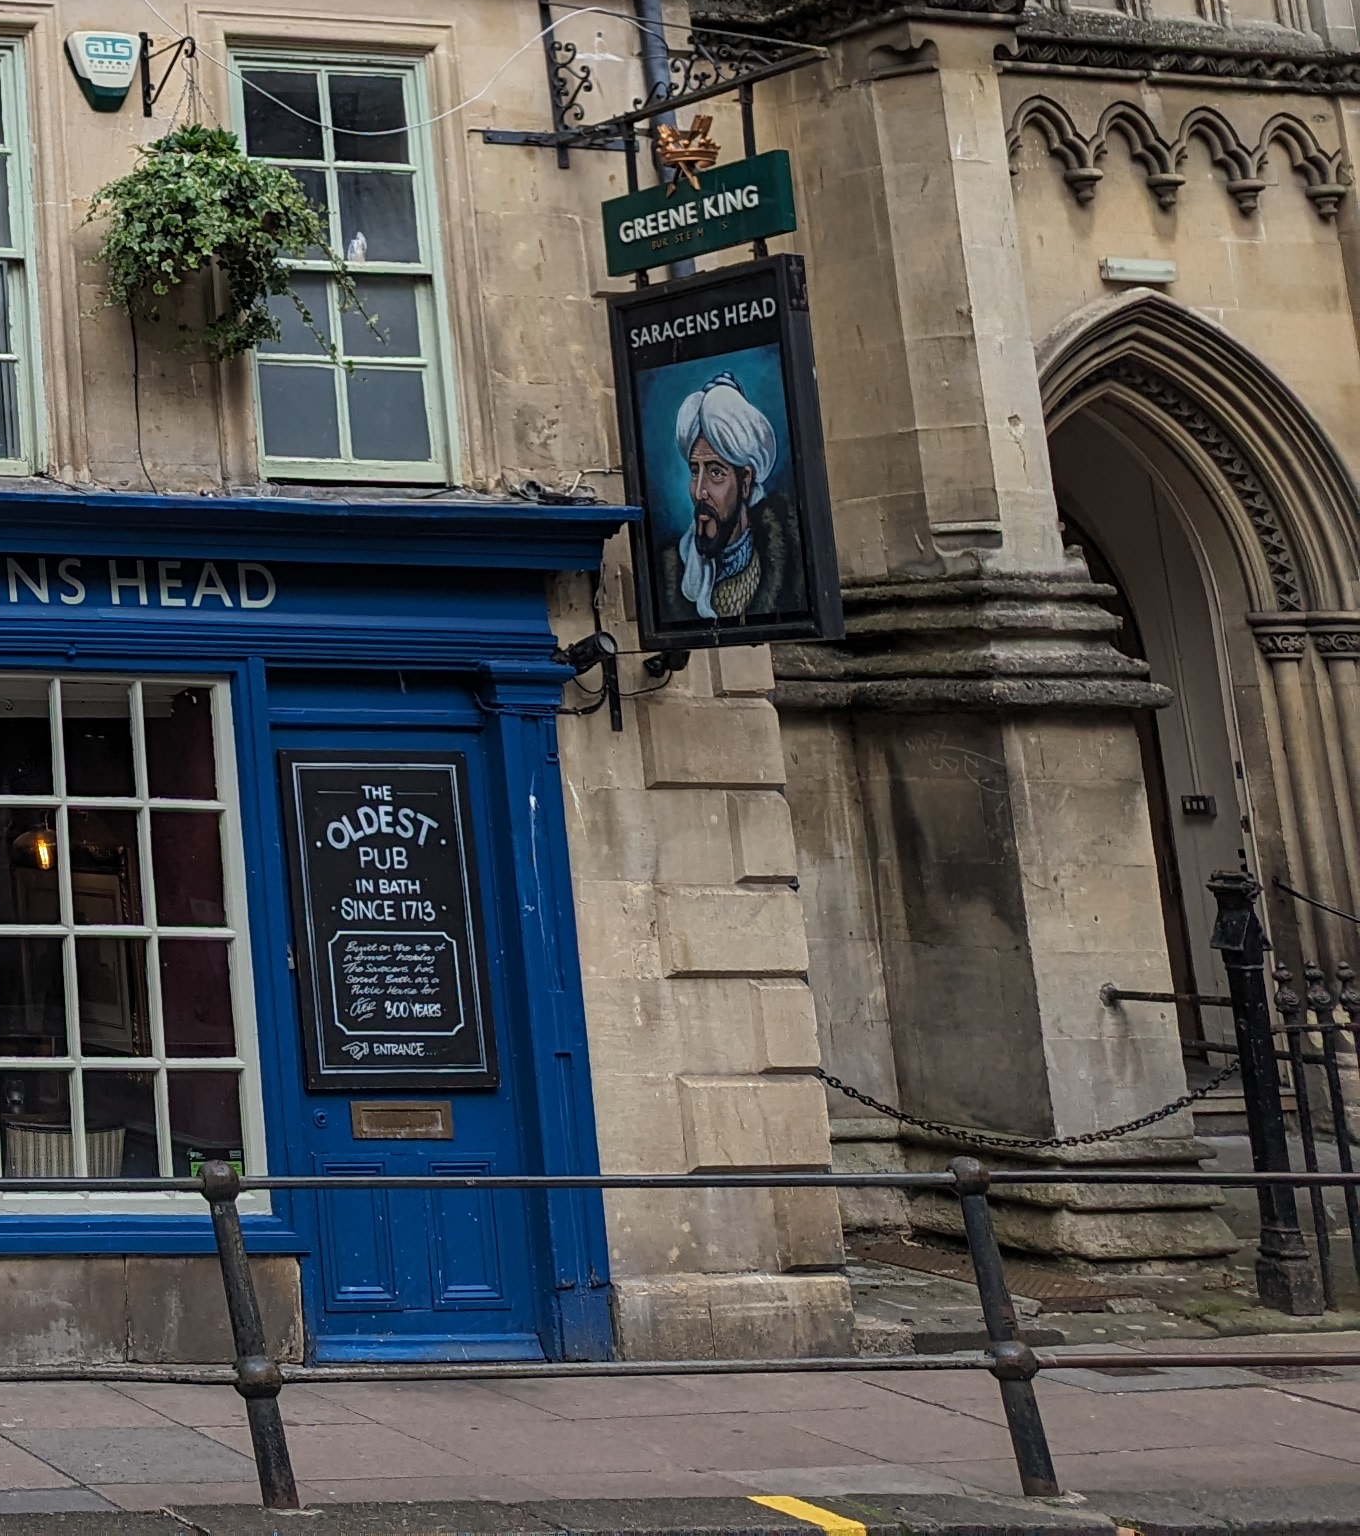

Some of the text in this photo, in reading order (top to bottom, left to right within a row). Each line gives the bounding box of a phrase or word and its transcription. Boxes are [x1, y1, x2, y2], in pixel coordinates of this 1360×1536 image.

[85, 38, 132, 58] ais
[618, 185, 759, 243] GREENE KING
[630, 297, 776, 348] SARACENS HEAD
[109, 559, 277, 610] HEAD
[361, 785, 393, 801] THE
[326, 805, 439, 849] OLDEST
[358, 846, 408, 869] PUB
[355, 878, 421, 894] IN BATH
[341, 897, 436, 921] SINCE 1713
[392, 943, 411, 952] the
[434, 942, 446, 953] of
[342, 961, 364, 973] The
[414, 976, 429, 984] as
[420, 983, 440, 995] for
[384, 1000, 409, 1019] 300
[410, 1001, 442, 1018] YEARS
